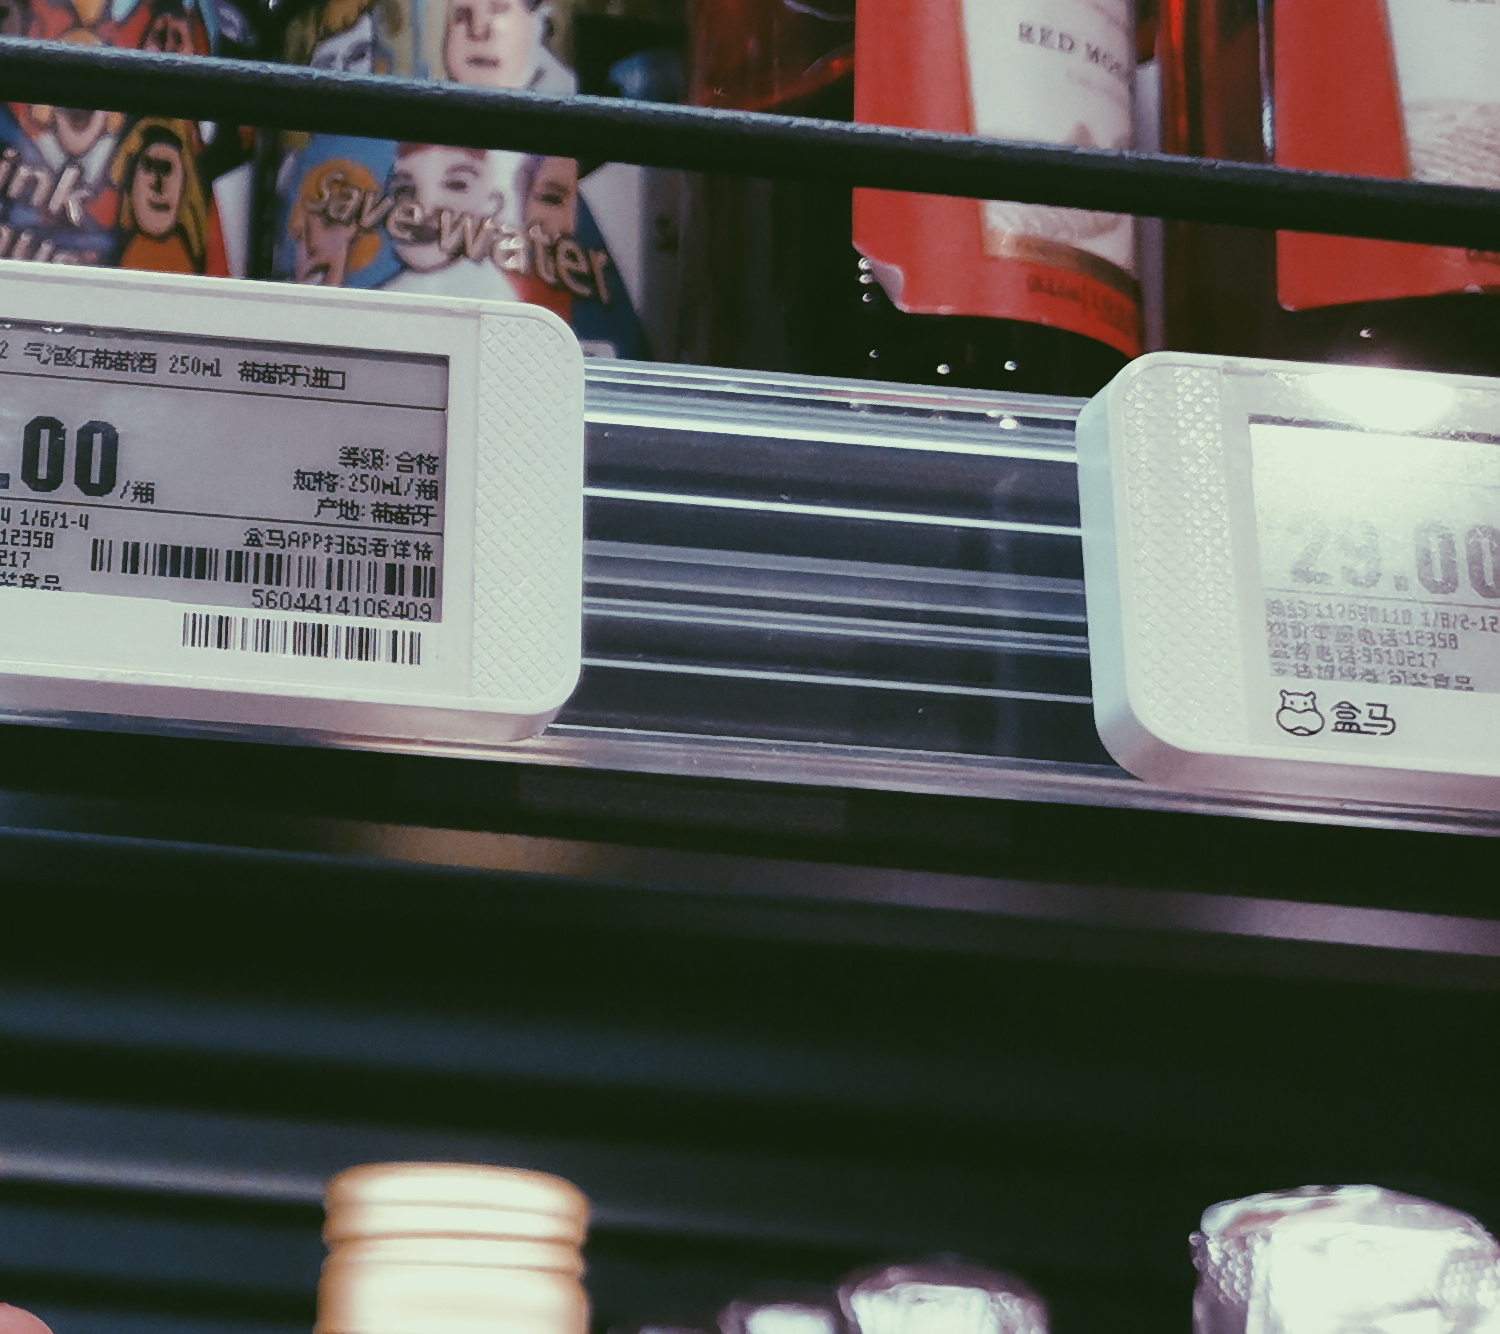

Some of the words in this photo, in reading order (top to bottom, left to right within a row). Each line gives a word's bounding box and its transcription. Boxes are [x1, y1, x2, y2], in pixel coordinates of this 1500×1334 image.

[168, 353, 223, 378] 250ml
[250, 588, 433, 623] 5604414106409
[1329, 700, 1397, 736] 盒马
